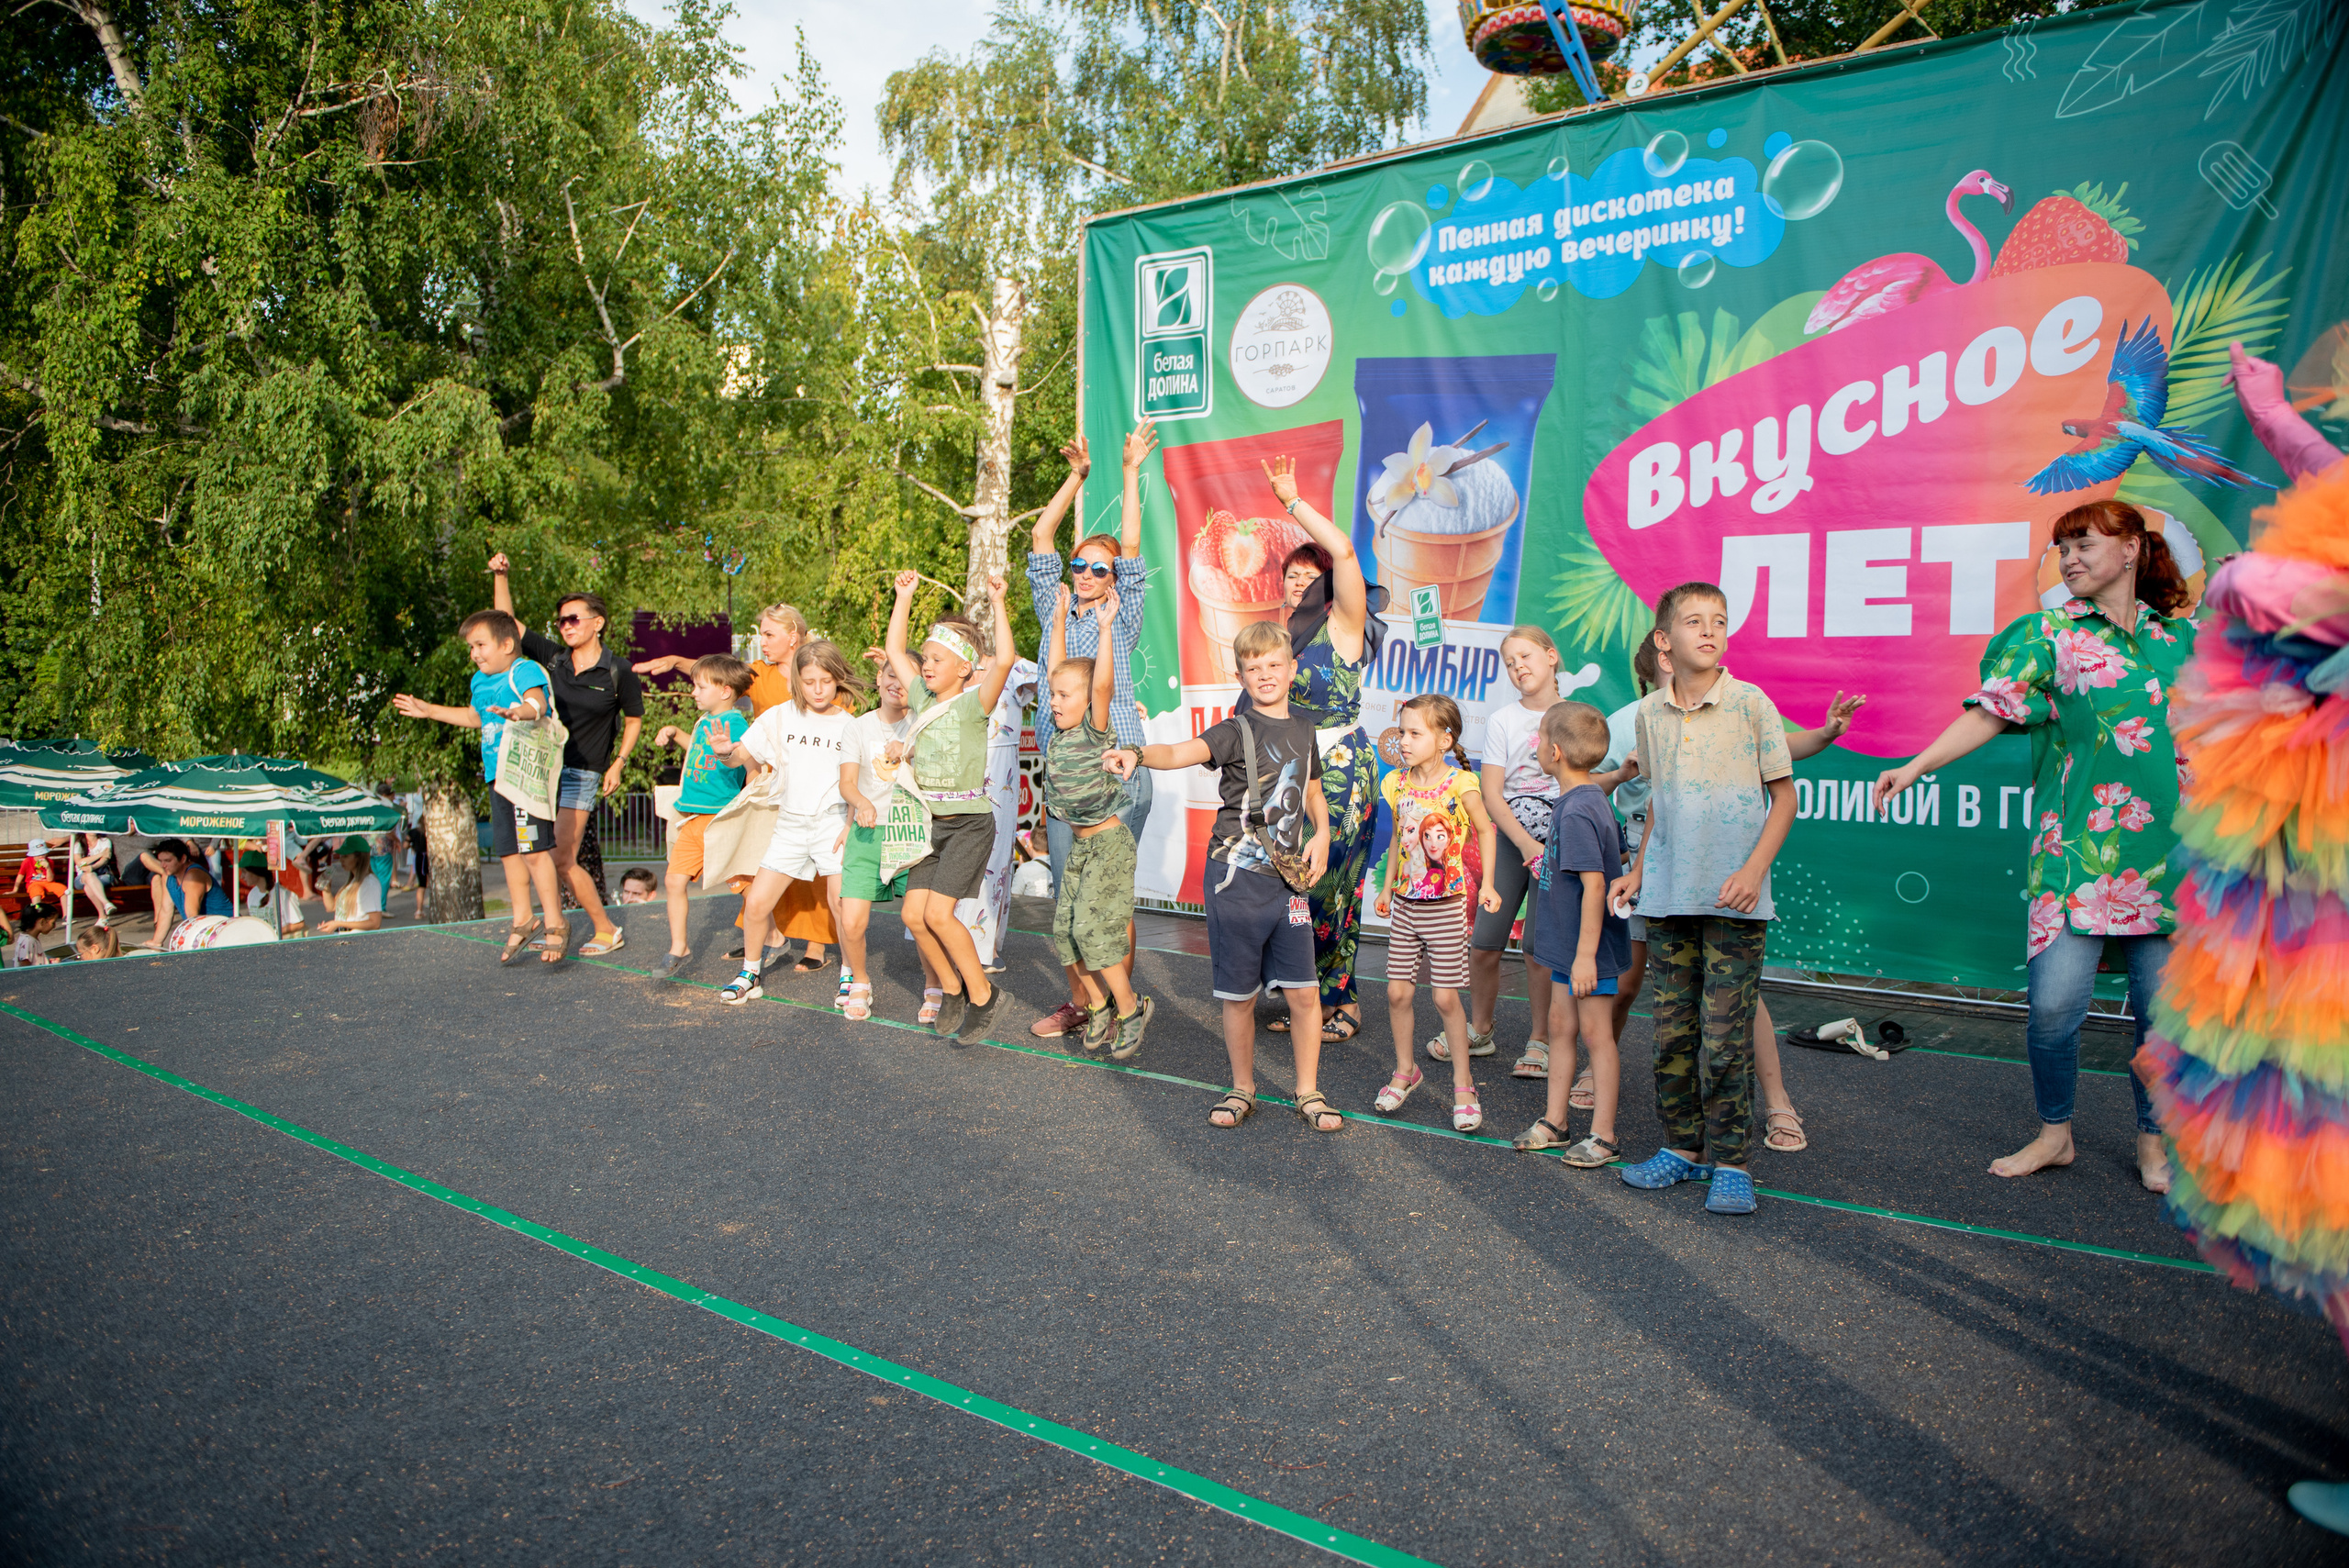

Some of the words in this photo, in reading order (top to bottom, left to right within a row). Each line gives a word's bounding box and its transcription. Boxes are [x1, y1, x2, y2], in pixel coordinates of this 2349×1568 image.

[1438, 213, 1543, 252] Пенная
[1553, 176, 1735, 239] дискотека
[1429, 246, 1551, 287] каждую
[1561, 206, 1745, 263] вечеринку!
[1235, 334, 1328, 362] ГОРПАРК
[1153, 351, 1194, 373] белая
[1147, 373, 1198, 402] ДОЛИНА
[1265, 384, 1296, 395] САРАТОВ
[1627, 295, 2103, 530] Вкусное
[1419, 622, 1436, 631] белая
[1419, 629, 1439, 642] ДОЛИНА
[1362, 639, 1500, 703] ЛОМБИР
[1361, 701, 1387, 713] СОКОЕ
[786, 734, 841, 751] PARIS
[1792, 774, 1940, 826] ОЛИНОЙ
[1957, 784, 1981, 828] В
[179, 816, 245, 828] МОРОЖЕНОЕ
[319, 816, 346, 828] белая
[346, 816, 374, 827] долина
